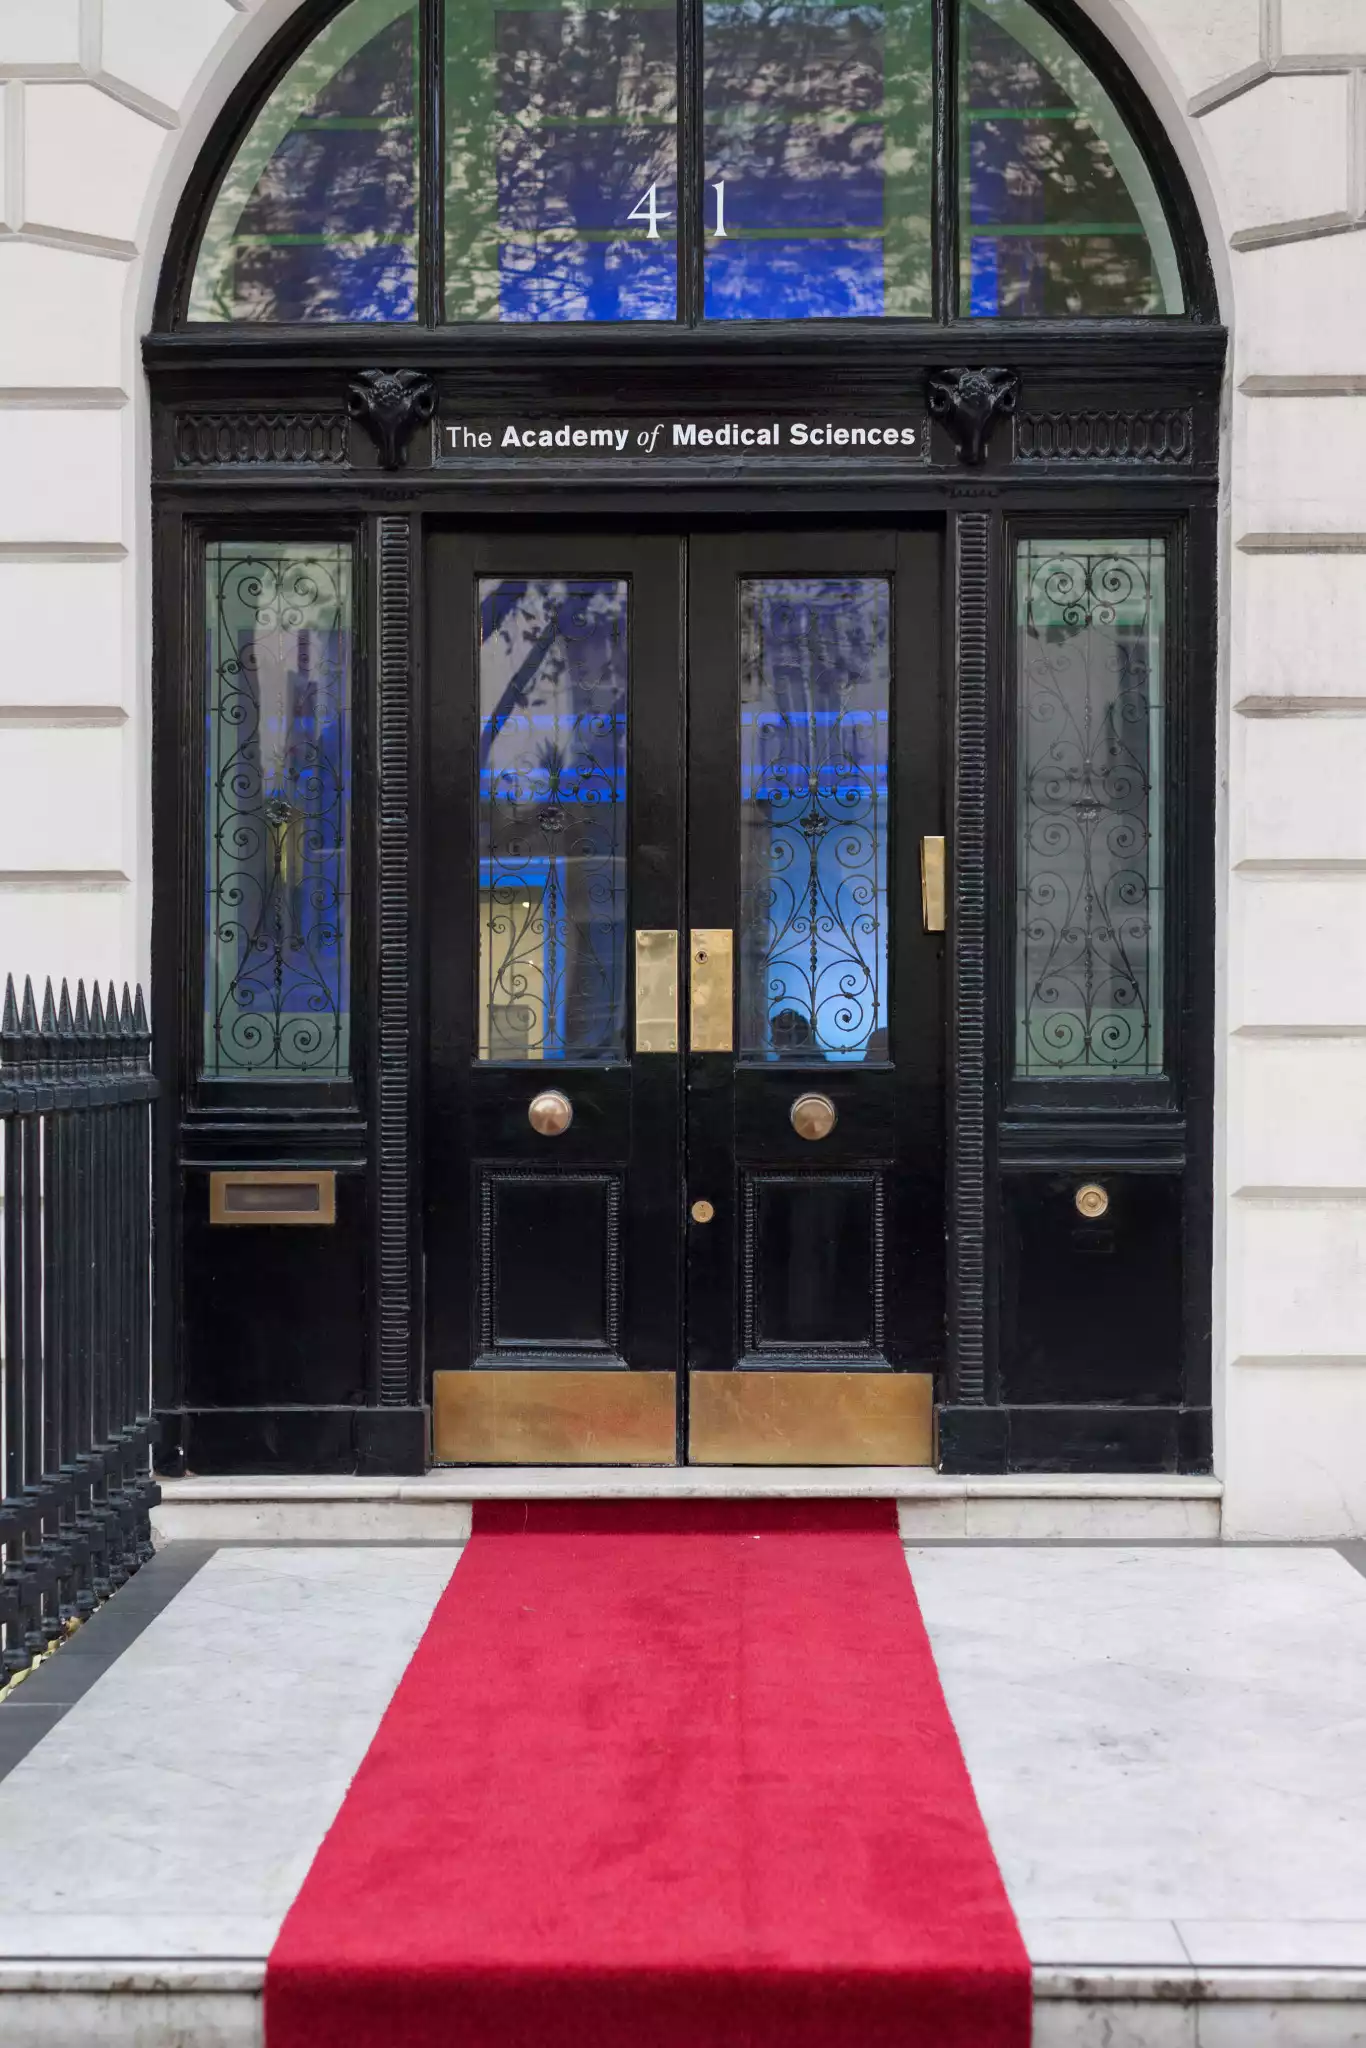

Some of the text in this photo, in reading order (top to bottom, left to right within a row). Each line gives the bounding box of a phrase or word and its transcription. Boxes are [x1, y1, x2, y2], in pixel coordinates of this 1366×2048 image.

[446, 422, 915, 453] The Academy of Medical Sciences
